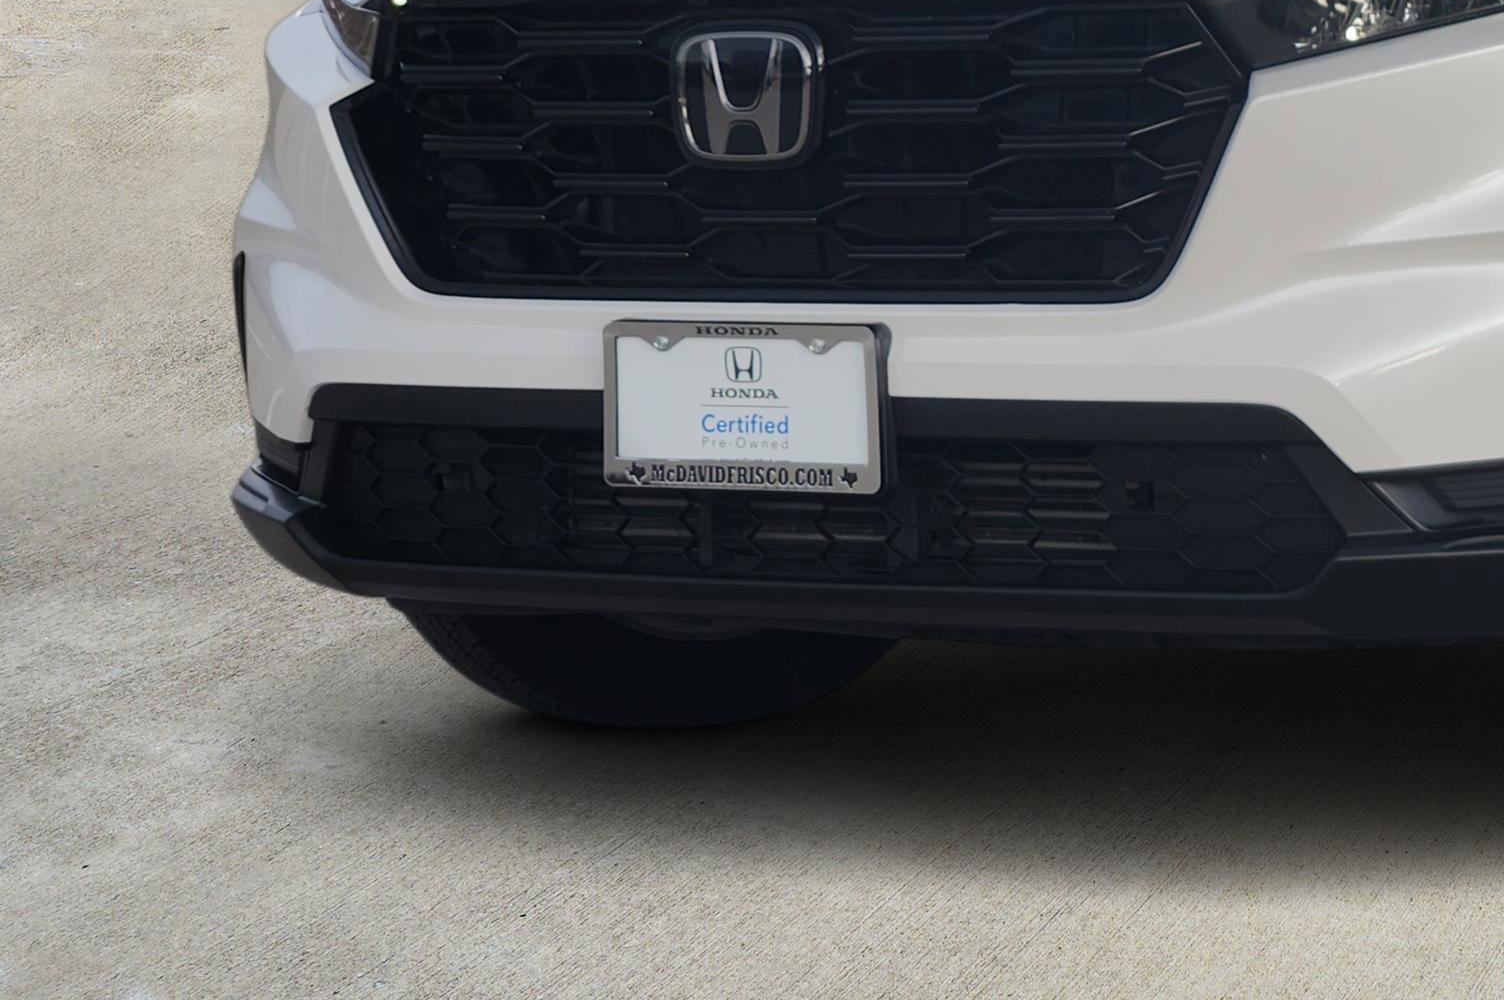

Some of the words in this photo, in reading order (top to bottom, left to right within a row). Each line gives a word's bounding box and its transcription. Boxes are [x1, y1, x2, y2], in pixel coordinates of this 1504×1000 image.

[695, 325, 779, 337] HONDA
[710, 387, 779, 399] HONDA
[701, 413, 790, 435] Certified
[701, 436, 790, 450] Pre-Owned
[650, 463, 834, 487] McDAVIDFRISCO.COM
